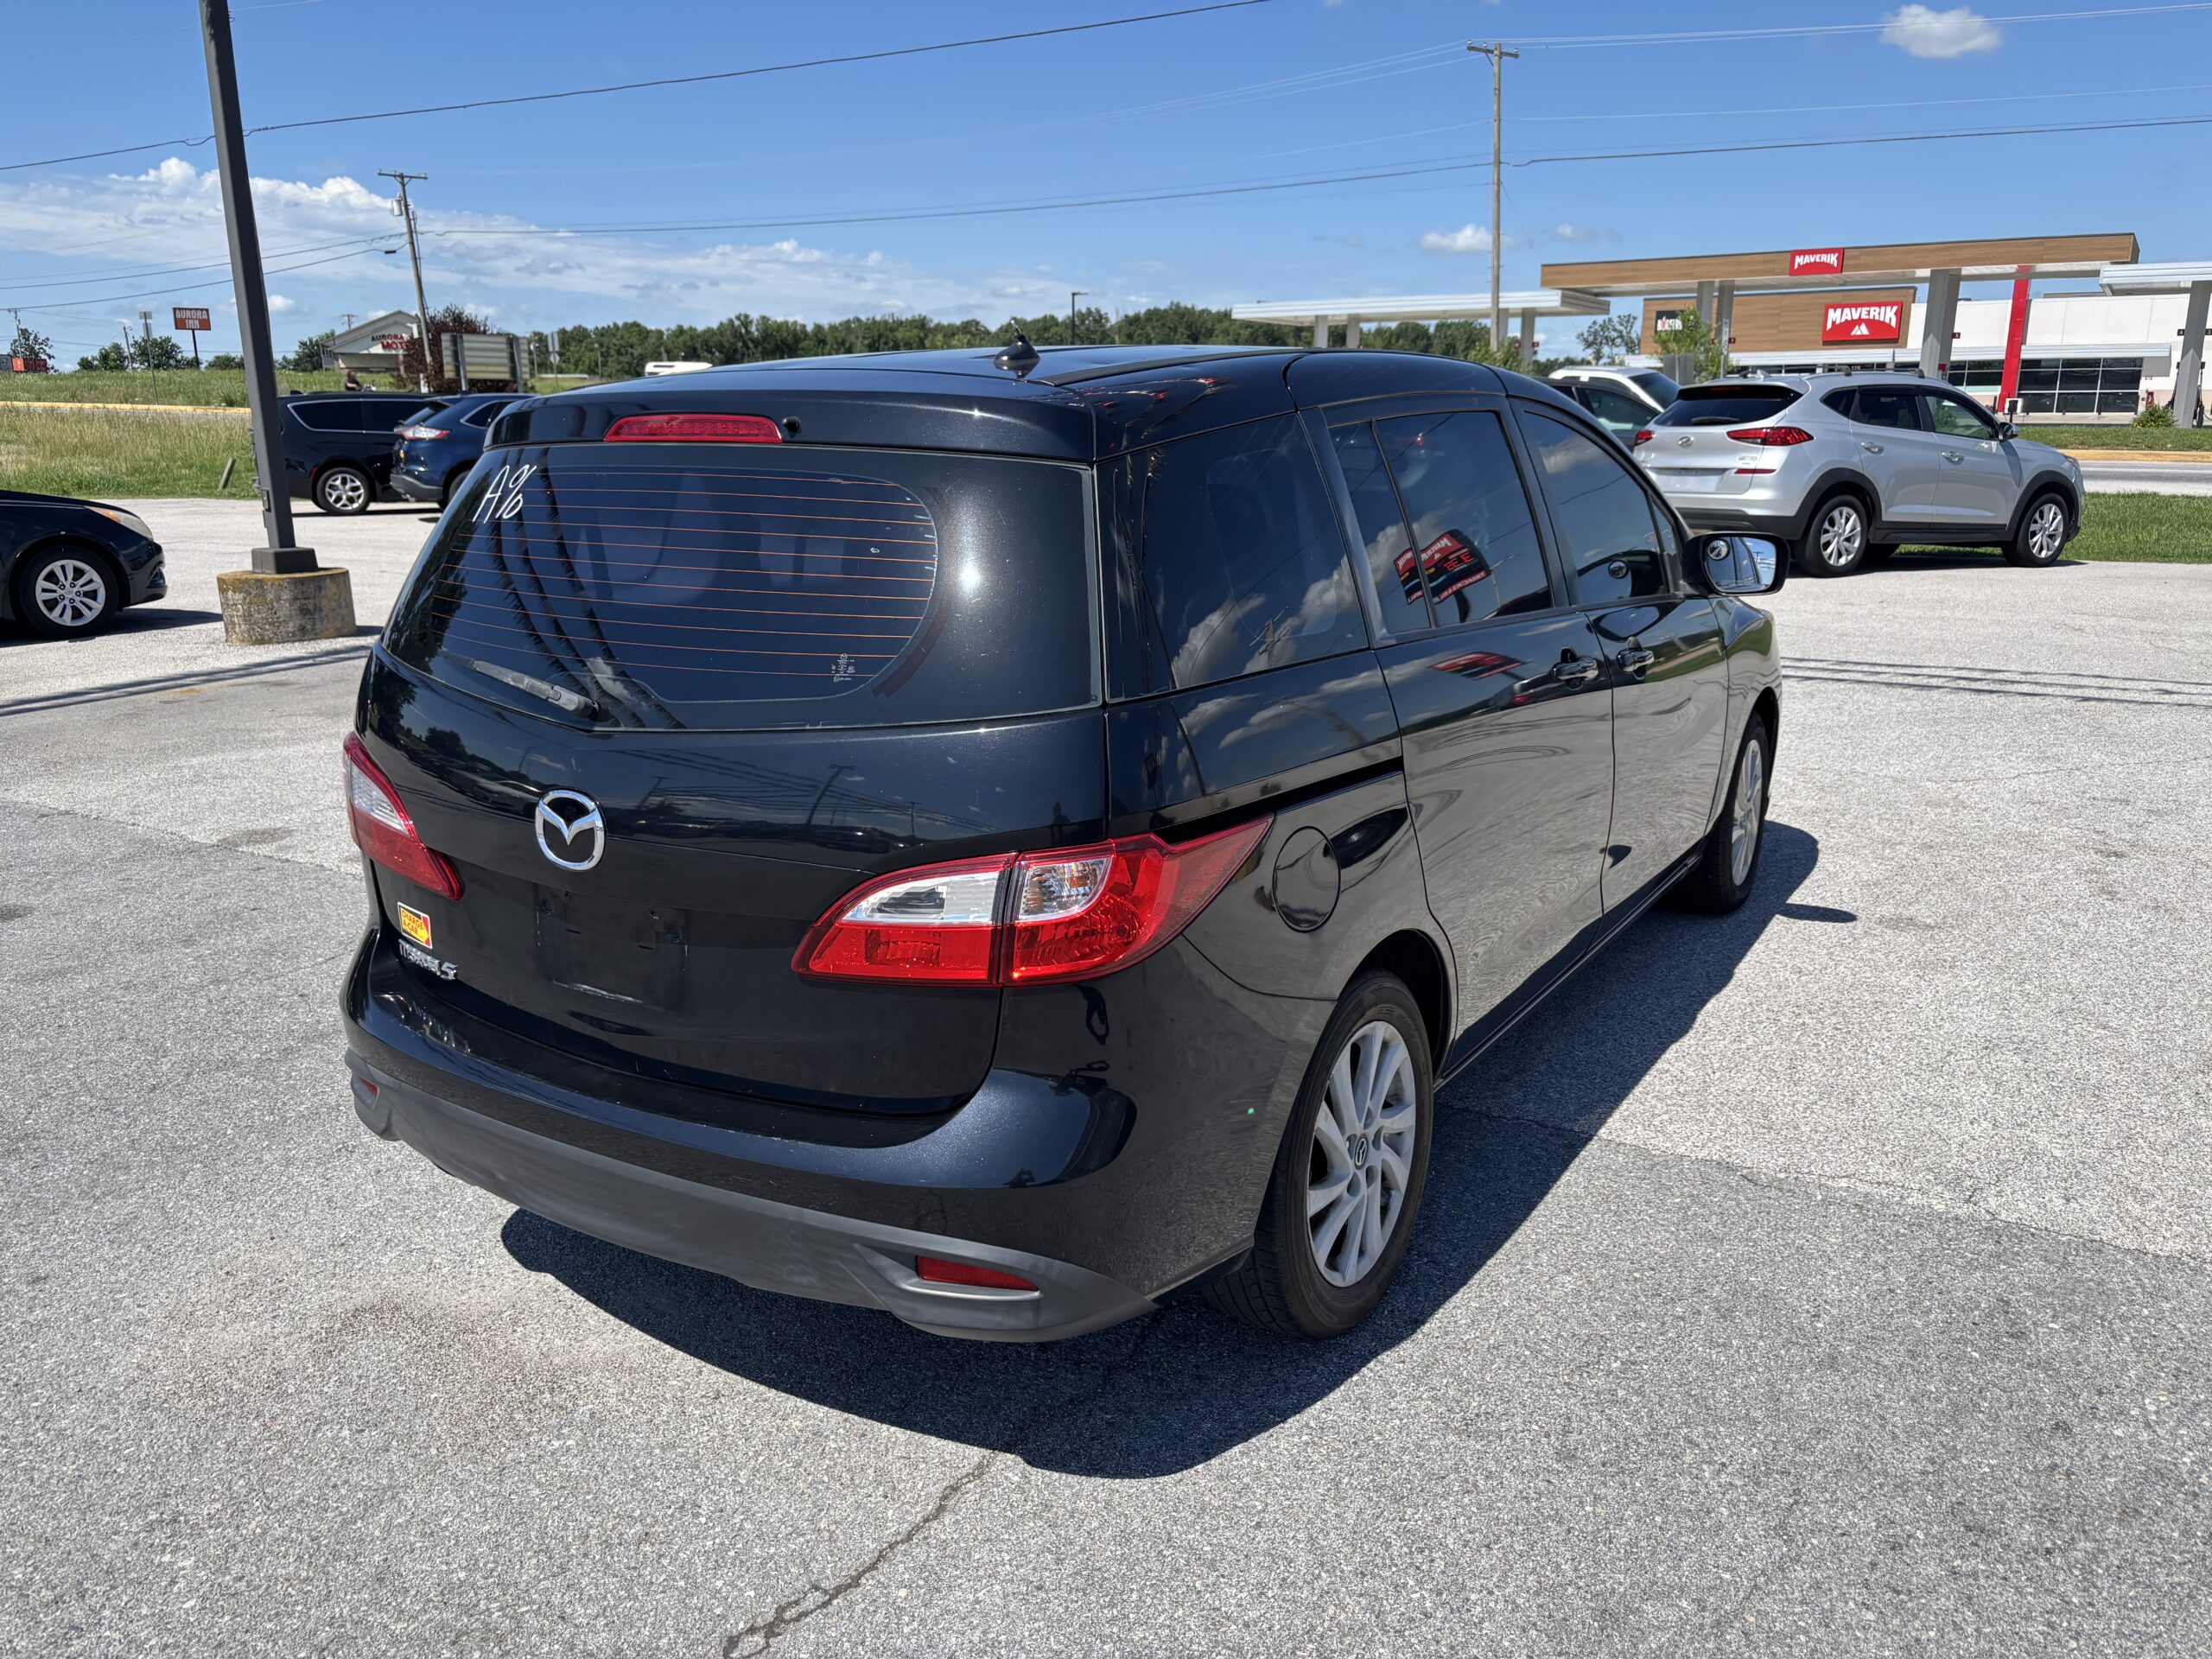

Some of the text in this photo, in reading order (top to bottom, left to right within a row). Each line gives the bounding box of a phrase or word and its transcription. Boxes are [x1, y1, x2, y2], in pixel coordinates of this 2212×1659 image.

[1794, 252, 1839, 270] MAVERIK
[175, 308, 208, 320] AURORA
[1826, 305, 1898, 332] MAVERIK
[185, 319, 200, 329] INN
